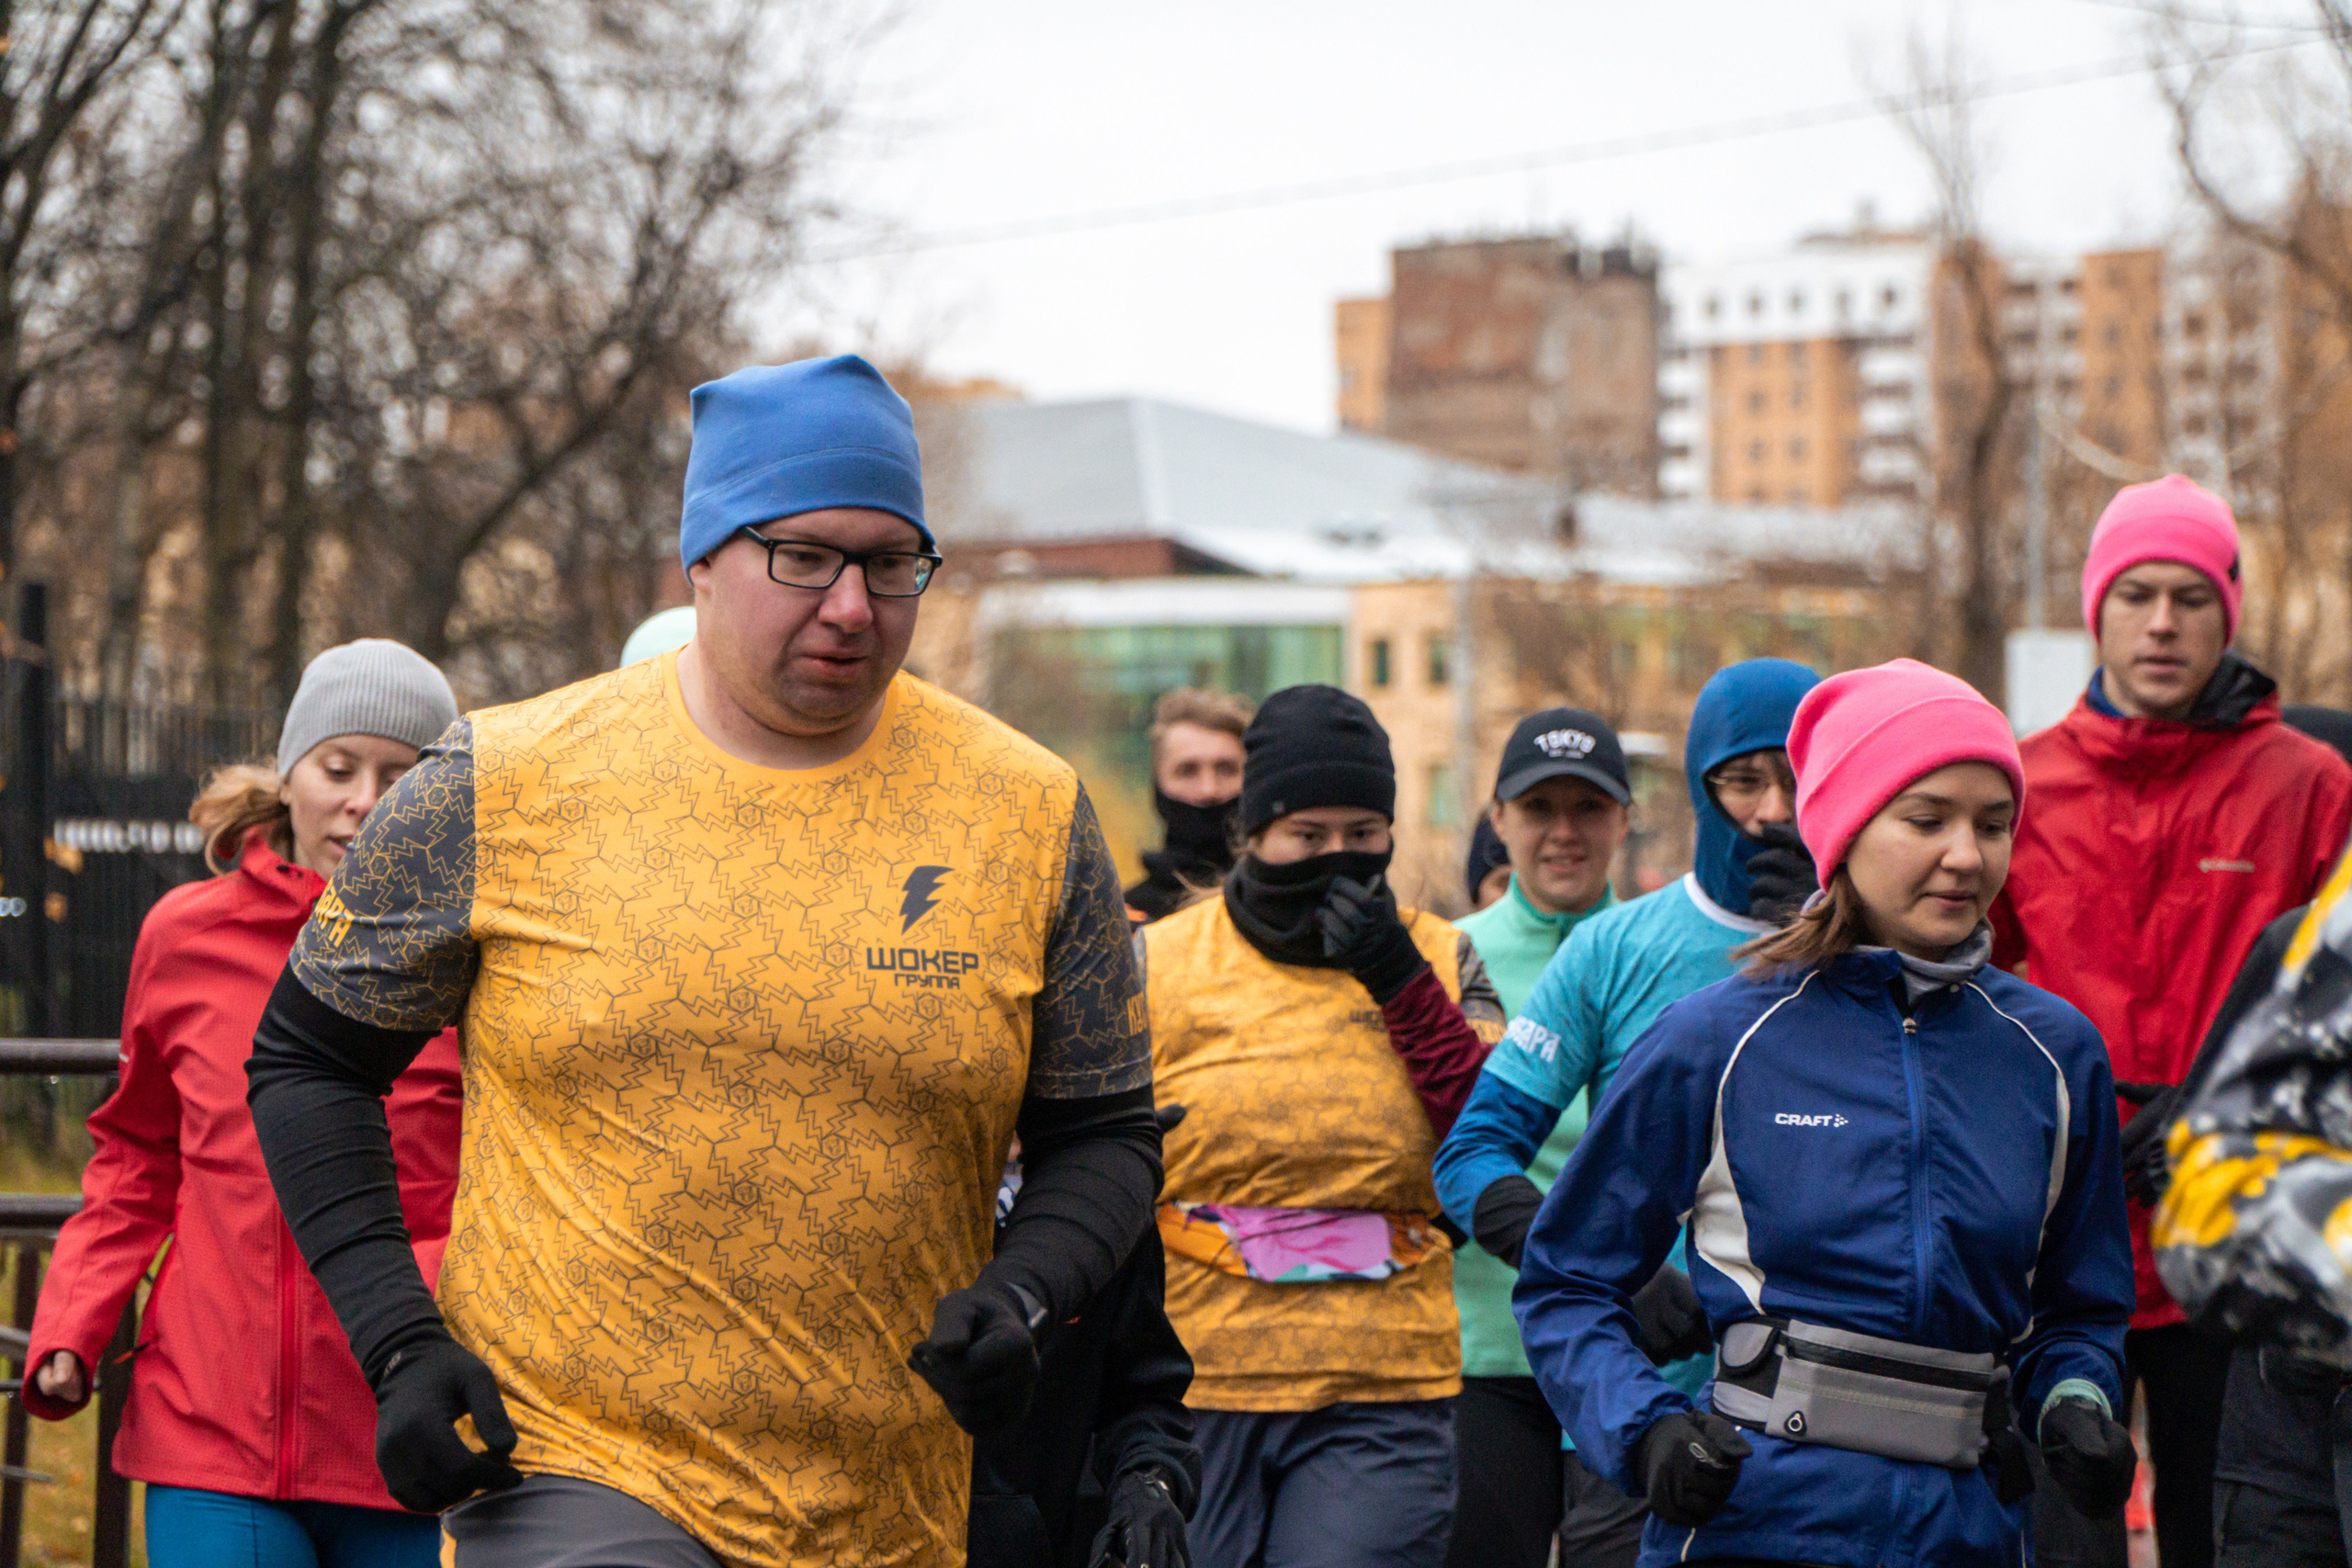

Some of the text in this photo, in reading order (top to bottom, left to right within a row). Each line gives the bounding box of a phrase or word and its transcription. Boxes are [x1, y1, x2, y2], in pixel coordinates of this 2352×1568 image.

[1533, 728, 1597, 753] TOKYO
[866, 947, 979, 975] ШОКЕР
[894, 974, 961, 989] ГРУППА
[1774, 1112, 1834, 1127] CRAFT
